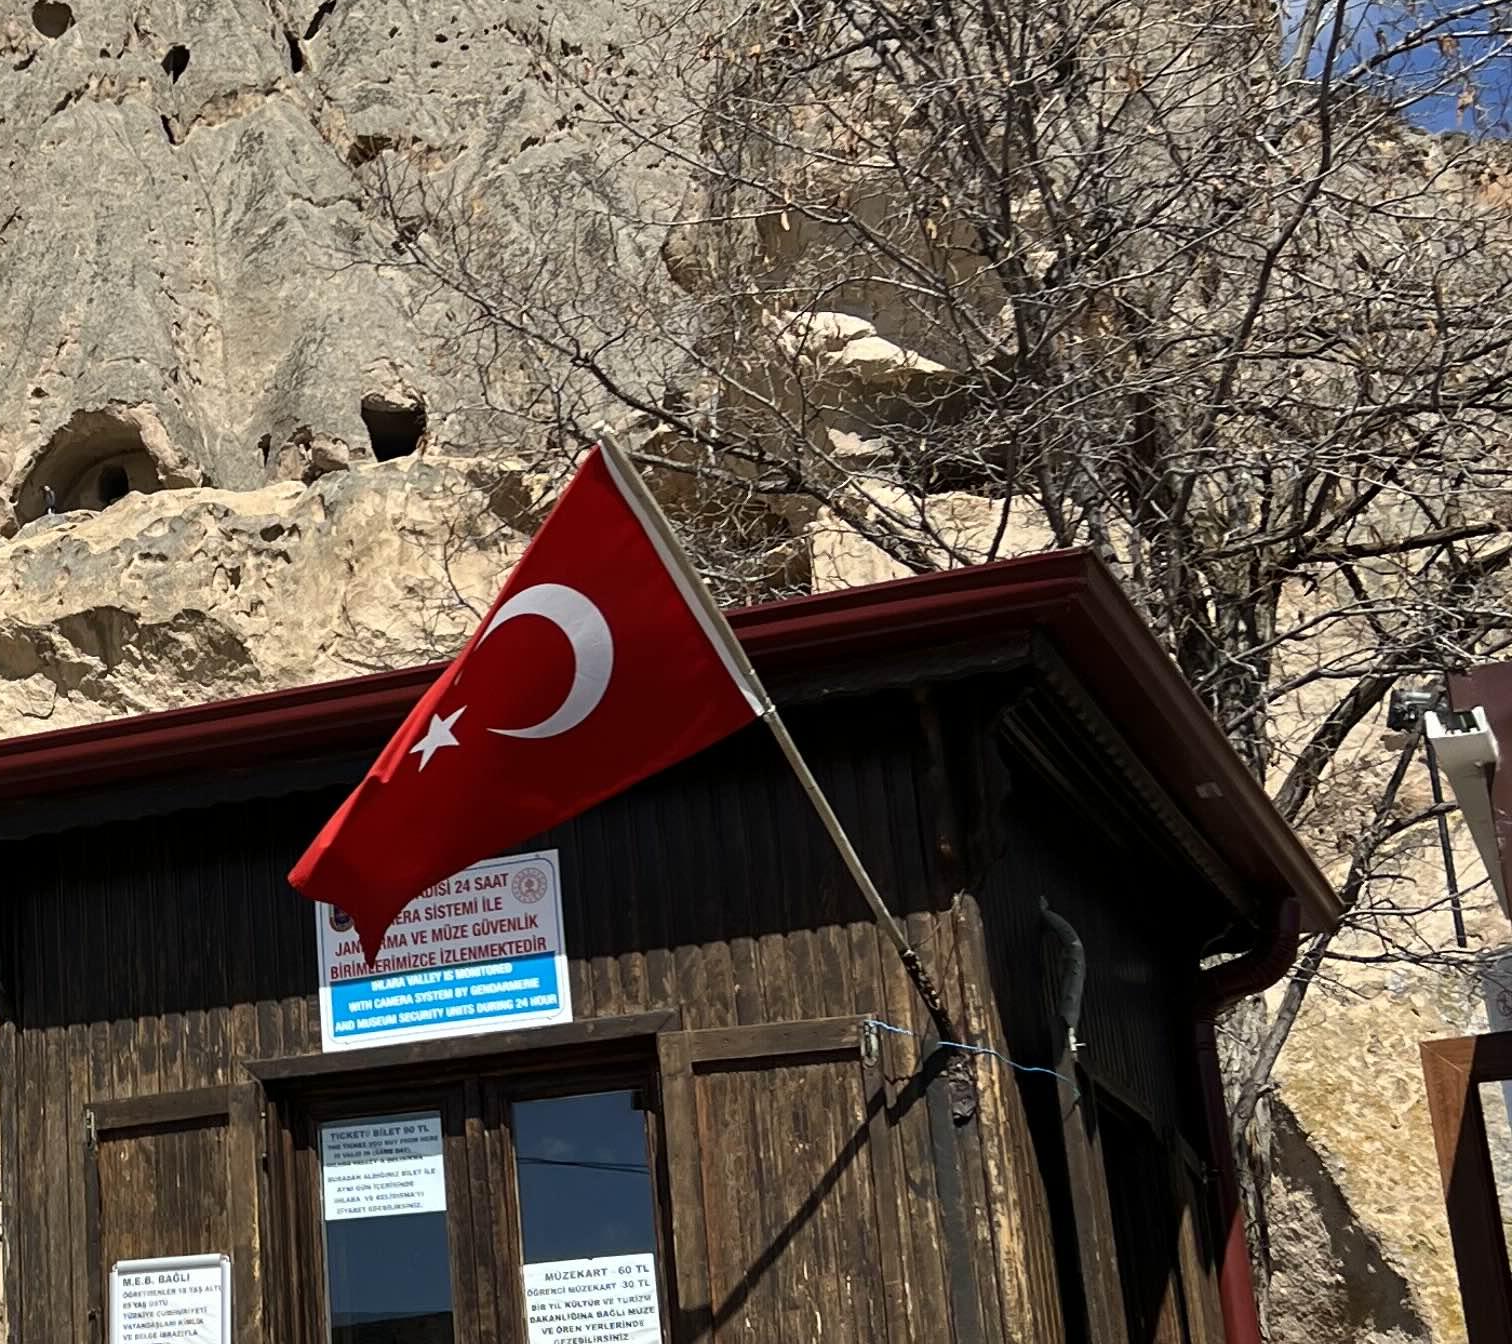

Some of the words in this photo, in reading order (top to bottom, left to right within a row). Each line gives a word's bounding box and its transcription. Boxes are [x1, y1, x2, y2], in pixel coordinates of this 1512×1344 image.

[455, 879, 471, 894] 24
[474, 872, 509, 891] SAAT
[425, 899, 478, 921] SİSTEMİ
[482, 896, 503, 913] İLE
[410, 930, 428, 945] VE
[431, 924, 468, 943] MÜZE
[472, 912, 539, 936] GÜVENLİK
[440, 934, 547, 964] İZLENMEKTEDİR
[406, 971, 442, 986] VALLEY
[443, 969, 454, 981] IS
[454, 962, 513, 980] MONITORED
[348, 1000, 373, 1013] WITH
[373, 993, 414, 1009] CAMERA
[414, 987, 453, 1003] SYSTEM
[454, 986, 469, 998] BY
[335, 1019, 355, 1033] AND
[356, 1013, 398, 1029] MUSEUM
[398, 1007, 444, 1023] SECURITY
[445, 1003, 475, 1017] UNITS
[475, 999, 514, 1014] DURING
[514, 997, 528, 1009] 24
[529, 993, 558, 1007] HOUR
[417, 1124, 430, 1133] TL
[158, 1272, 190, 1284] BAĞLI
[618, 1265, 632, 1275] 60
[635, 1264, 650, 1273] TL
[622, 1280, 634, 1289] 30
[638, 1279, 650, 1287] TL
[542, 1327, 553, 1335] VE
